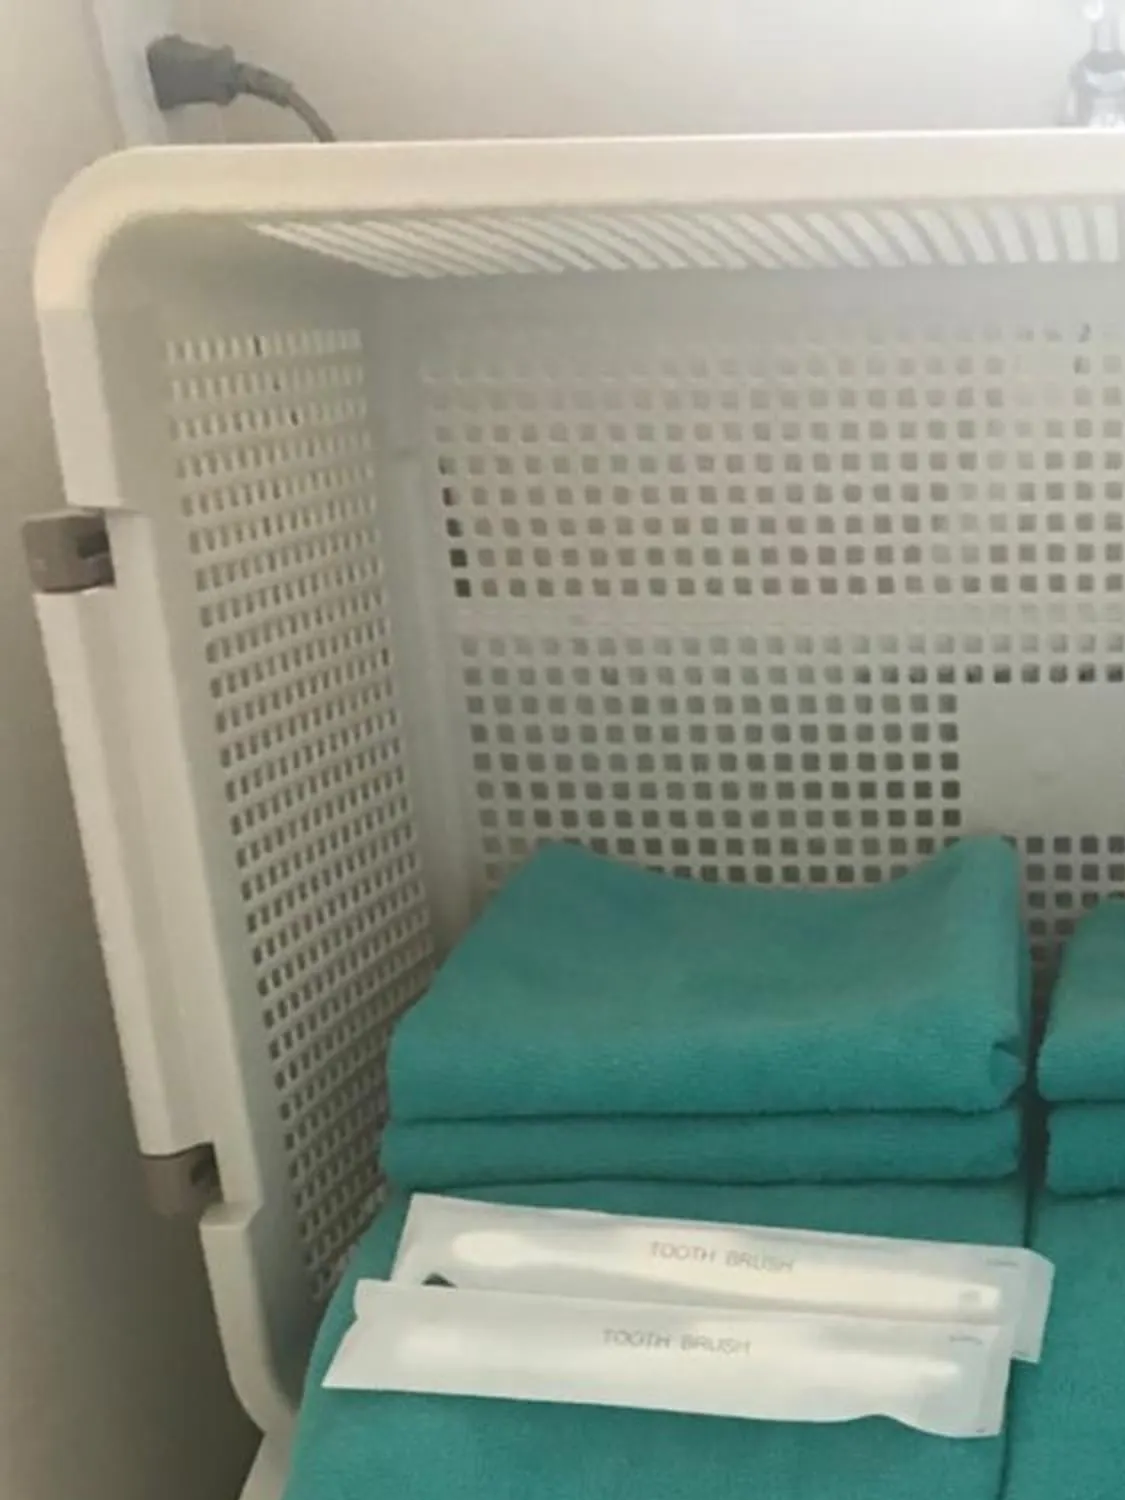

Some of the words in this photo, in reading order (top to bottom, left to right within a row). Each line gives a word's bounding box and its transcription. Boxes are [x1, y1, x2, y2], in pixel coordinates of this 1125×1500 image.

[650, 1240, 716, 1264] TOOTH
[724, 1249, 795, 1274] BRUSH
[602, 1328, 672, 1350] TOOTH
[680, 1333, 752, 1356] BRUSH
